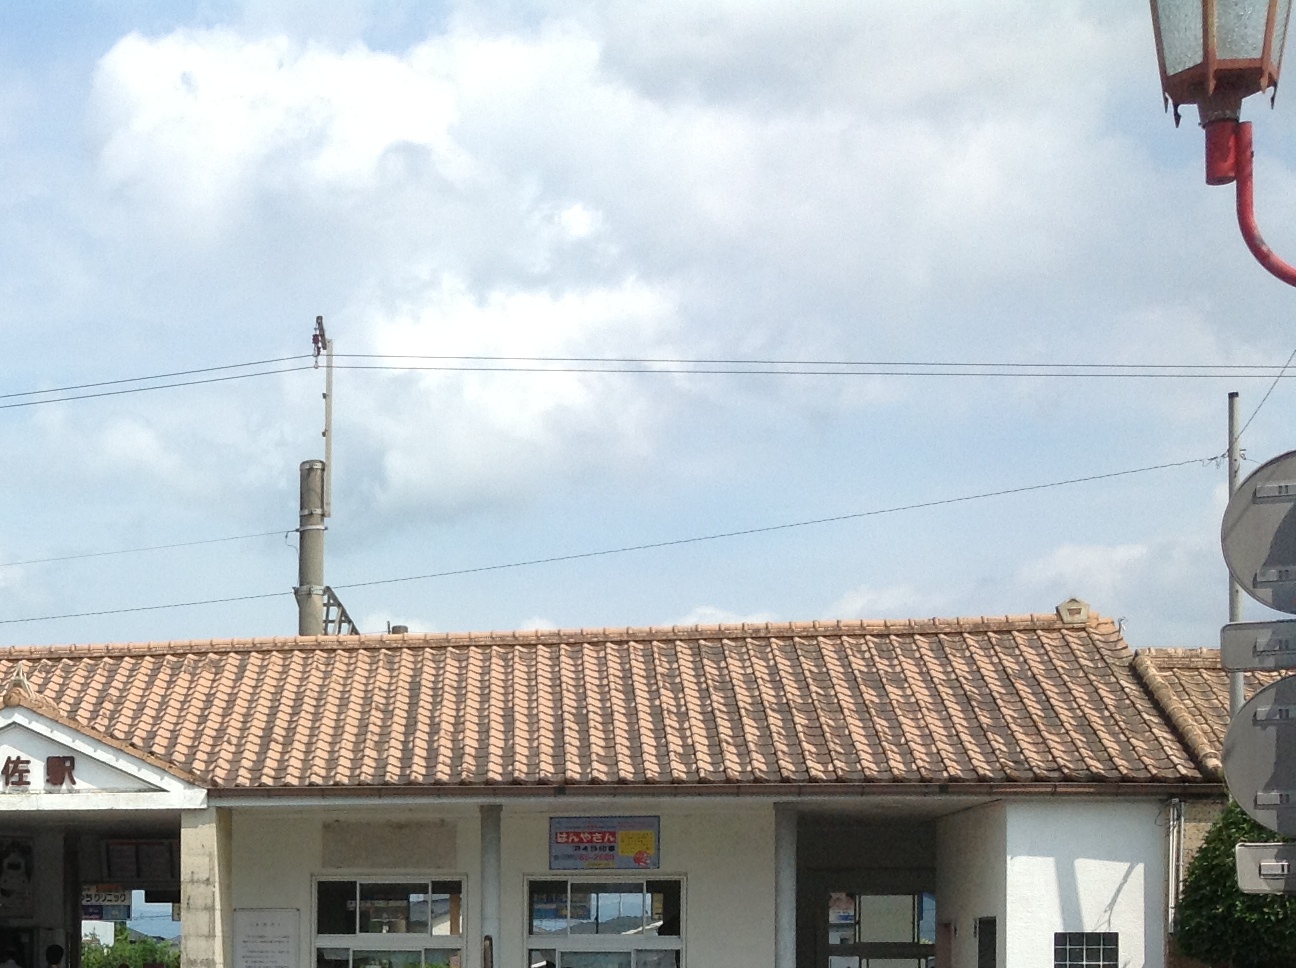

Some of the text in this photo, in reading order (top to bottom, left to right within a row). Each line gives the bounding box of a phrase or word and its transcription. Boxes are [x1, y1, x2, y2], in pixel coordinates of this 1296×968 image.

[556, 832, 615, 843] はんやさん
